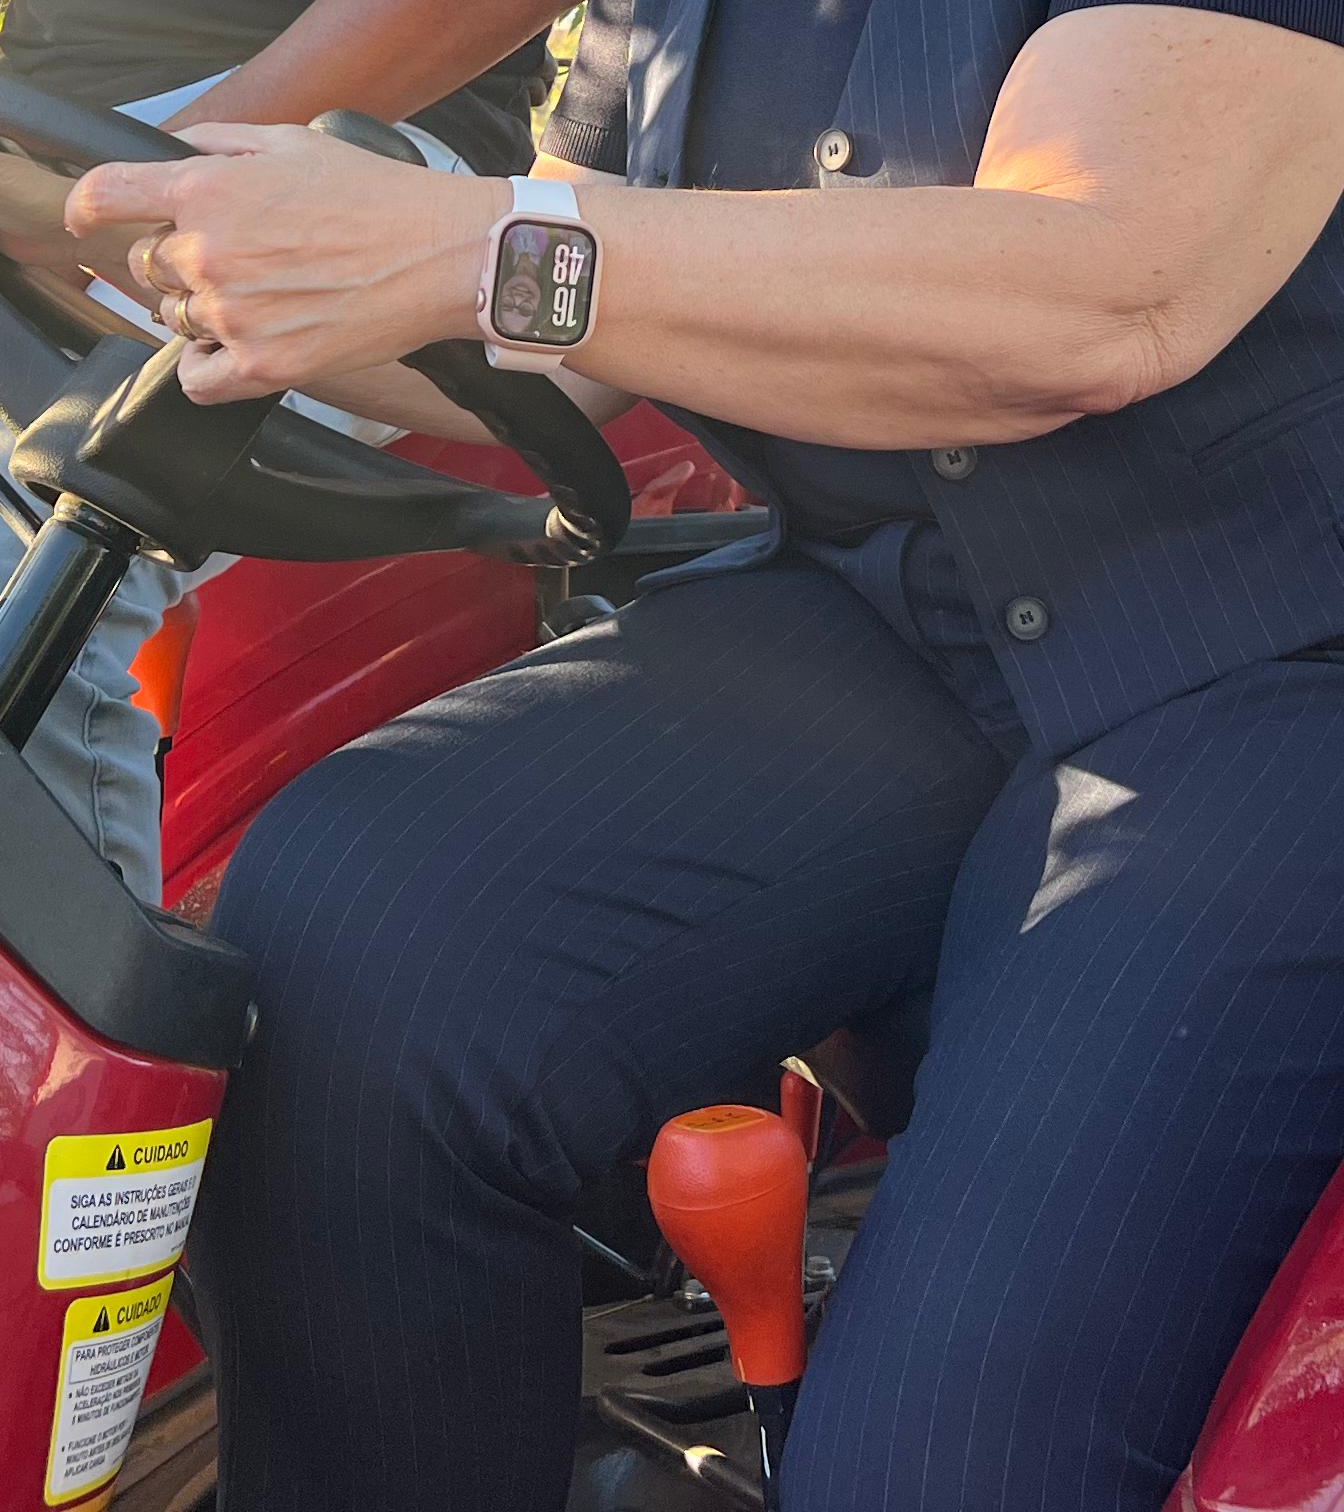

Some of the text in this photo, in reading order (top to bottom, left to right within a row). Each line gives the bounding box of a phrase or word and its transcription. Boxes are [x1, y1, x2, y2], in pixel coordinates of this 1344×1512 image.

[552, 243, 585, 285] 48
[551, 286, 578, 328] 16
[133, 1140, 189, 1165] CUIDADO
[70, 1194, 96, 1210] SIGA
[98, 1192, 112, 1207] AS
[114, 1183, 167, 1206] INSTRUÇÕES
[71, 1210, 135, 1230] CALENDÁRIO
[136, 1208, 148, 1223] DE
[53, 1234, 113, 1254] CONFORME
[115, 1231, 122, 1248] É
[123, 1226, 165, 1246] PRESCRITO
[117, 1292, 162, 1325] CUIDADO
[75, 1348, 96, 1362] PARA
